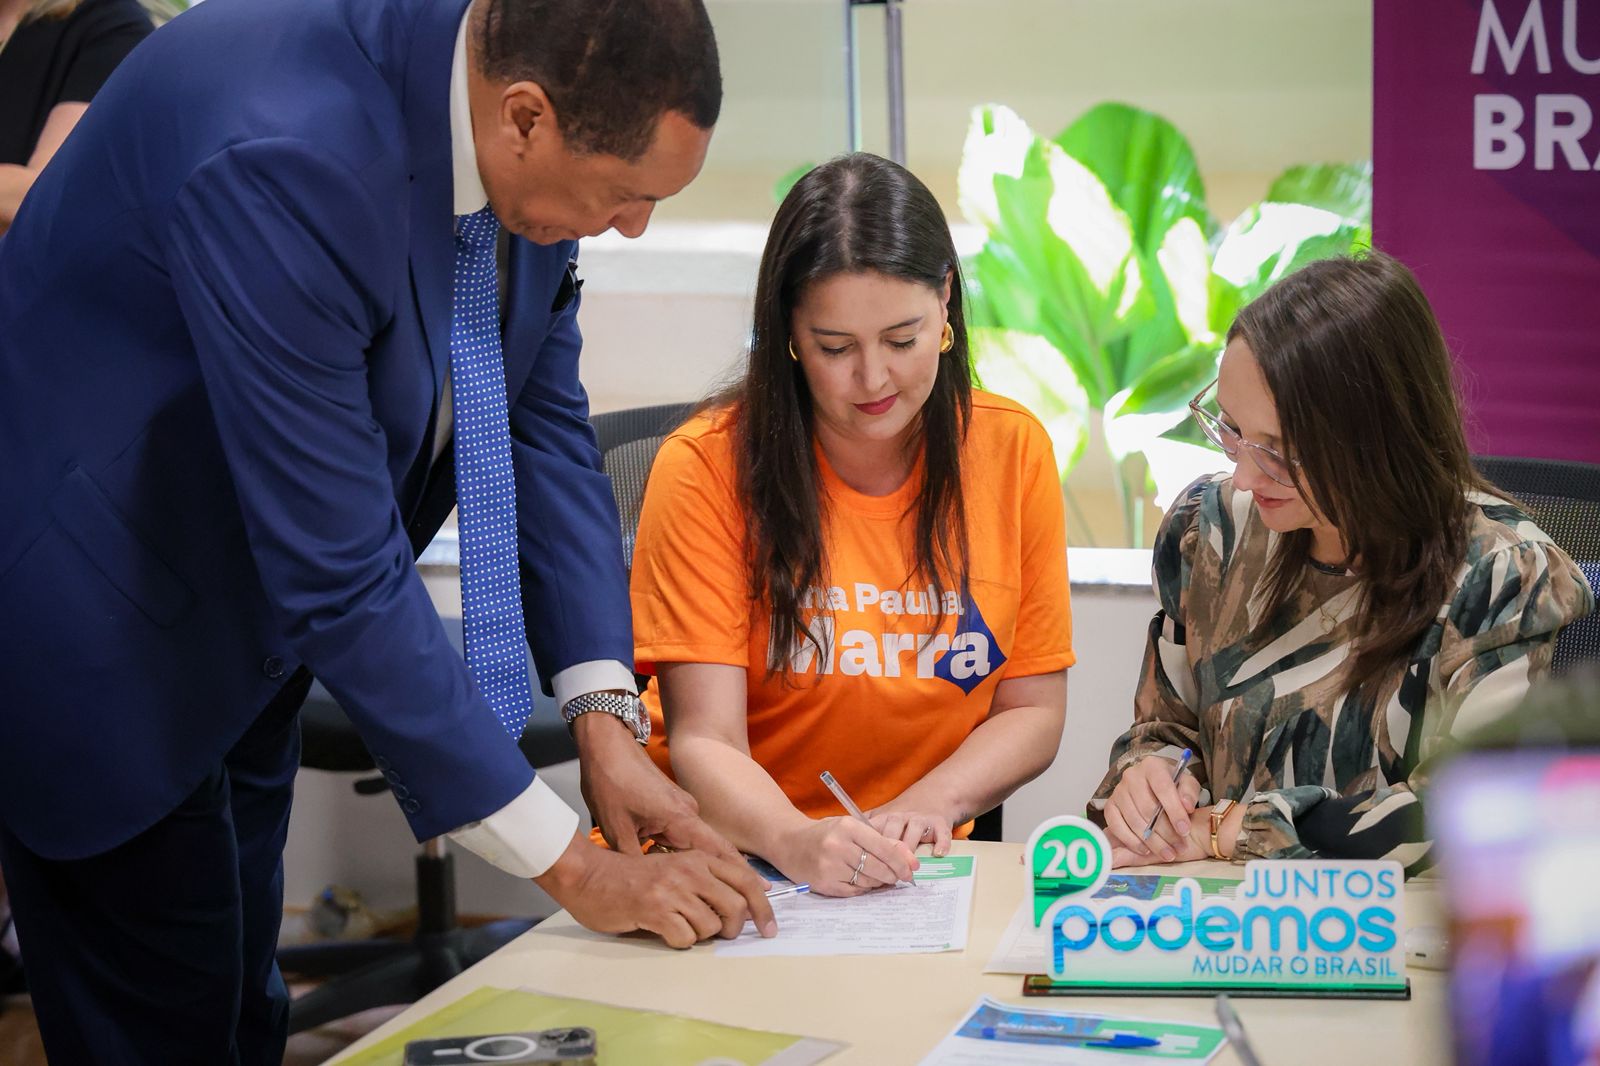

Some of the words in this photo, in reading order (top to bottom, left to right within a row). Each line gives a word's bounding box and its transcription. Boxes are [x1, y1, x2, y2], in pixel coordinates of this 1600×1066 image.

[1473, 93, 1600, 171] BR
[796, 584, 849, 612] na
[854, 582, 965, 616] Paula
[766, 615, 991, 680] Marra
[1040, 838, 1097, 879] 20
[1244, 868, 1397, 899] JUNTOS
[1052, 886, 1398, 975] podemos
[1192, 955, 1284, 976] MUDAR
[1289, 955, 1309, 976] O
[1314, 956, 1398, 977] BRASIL
